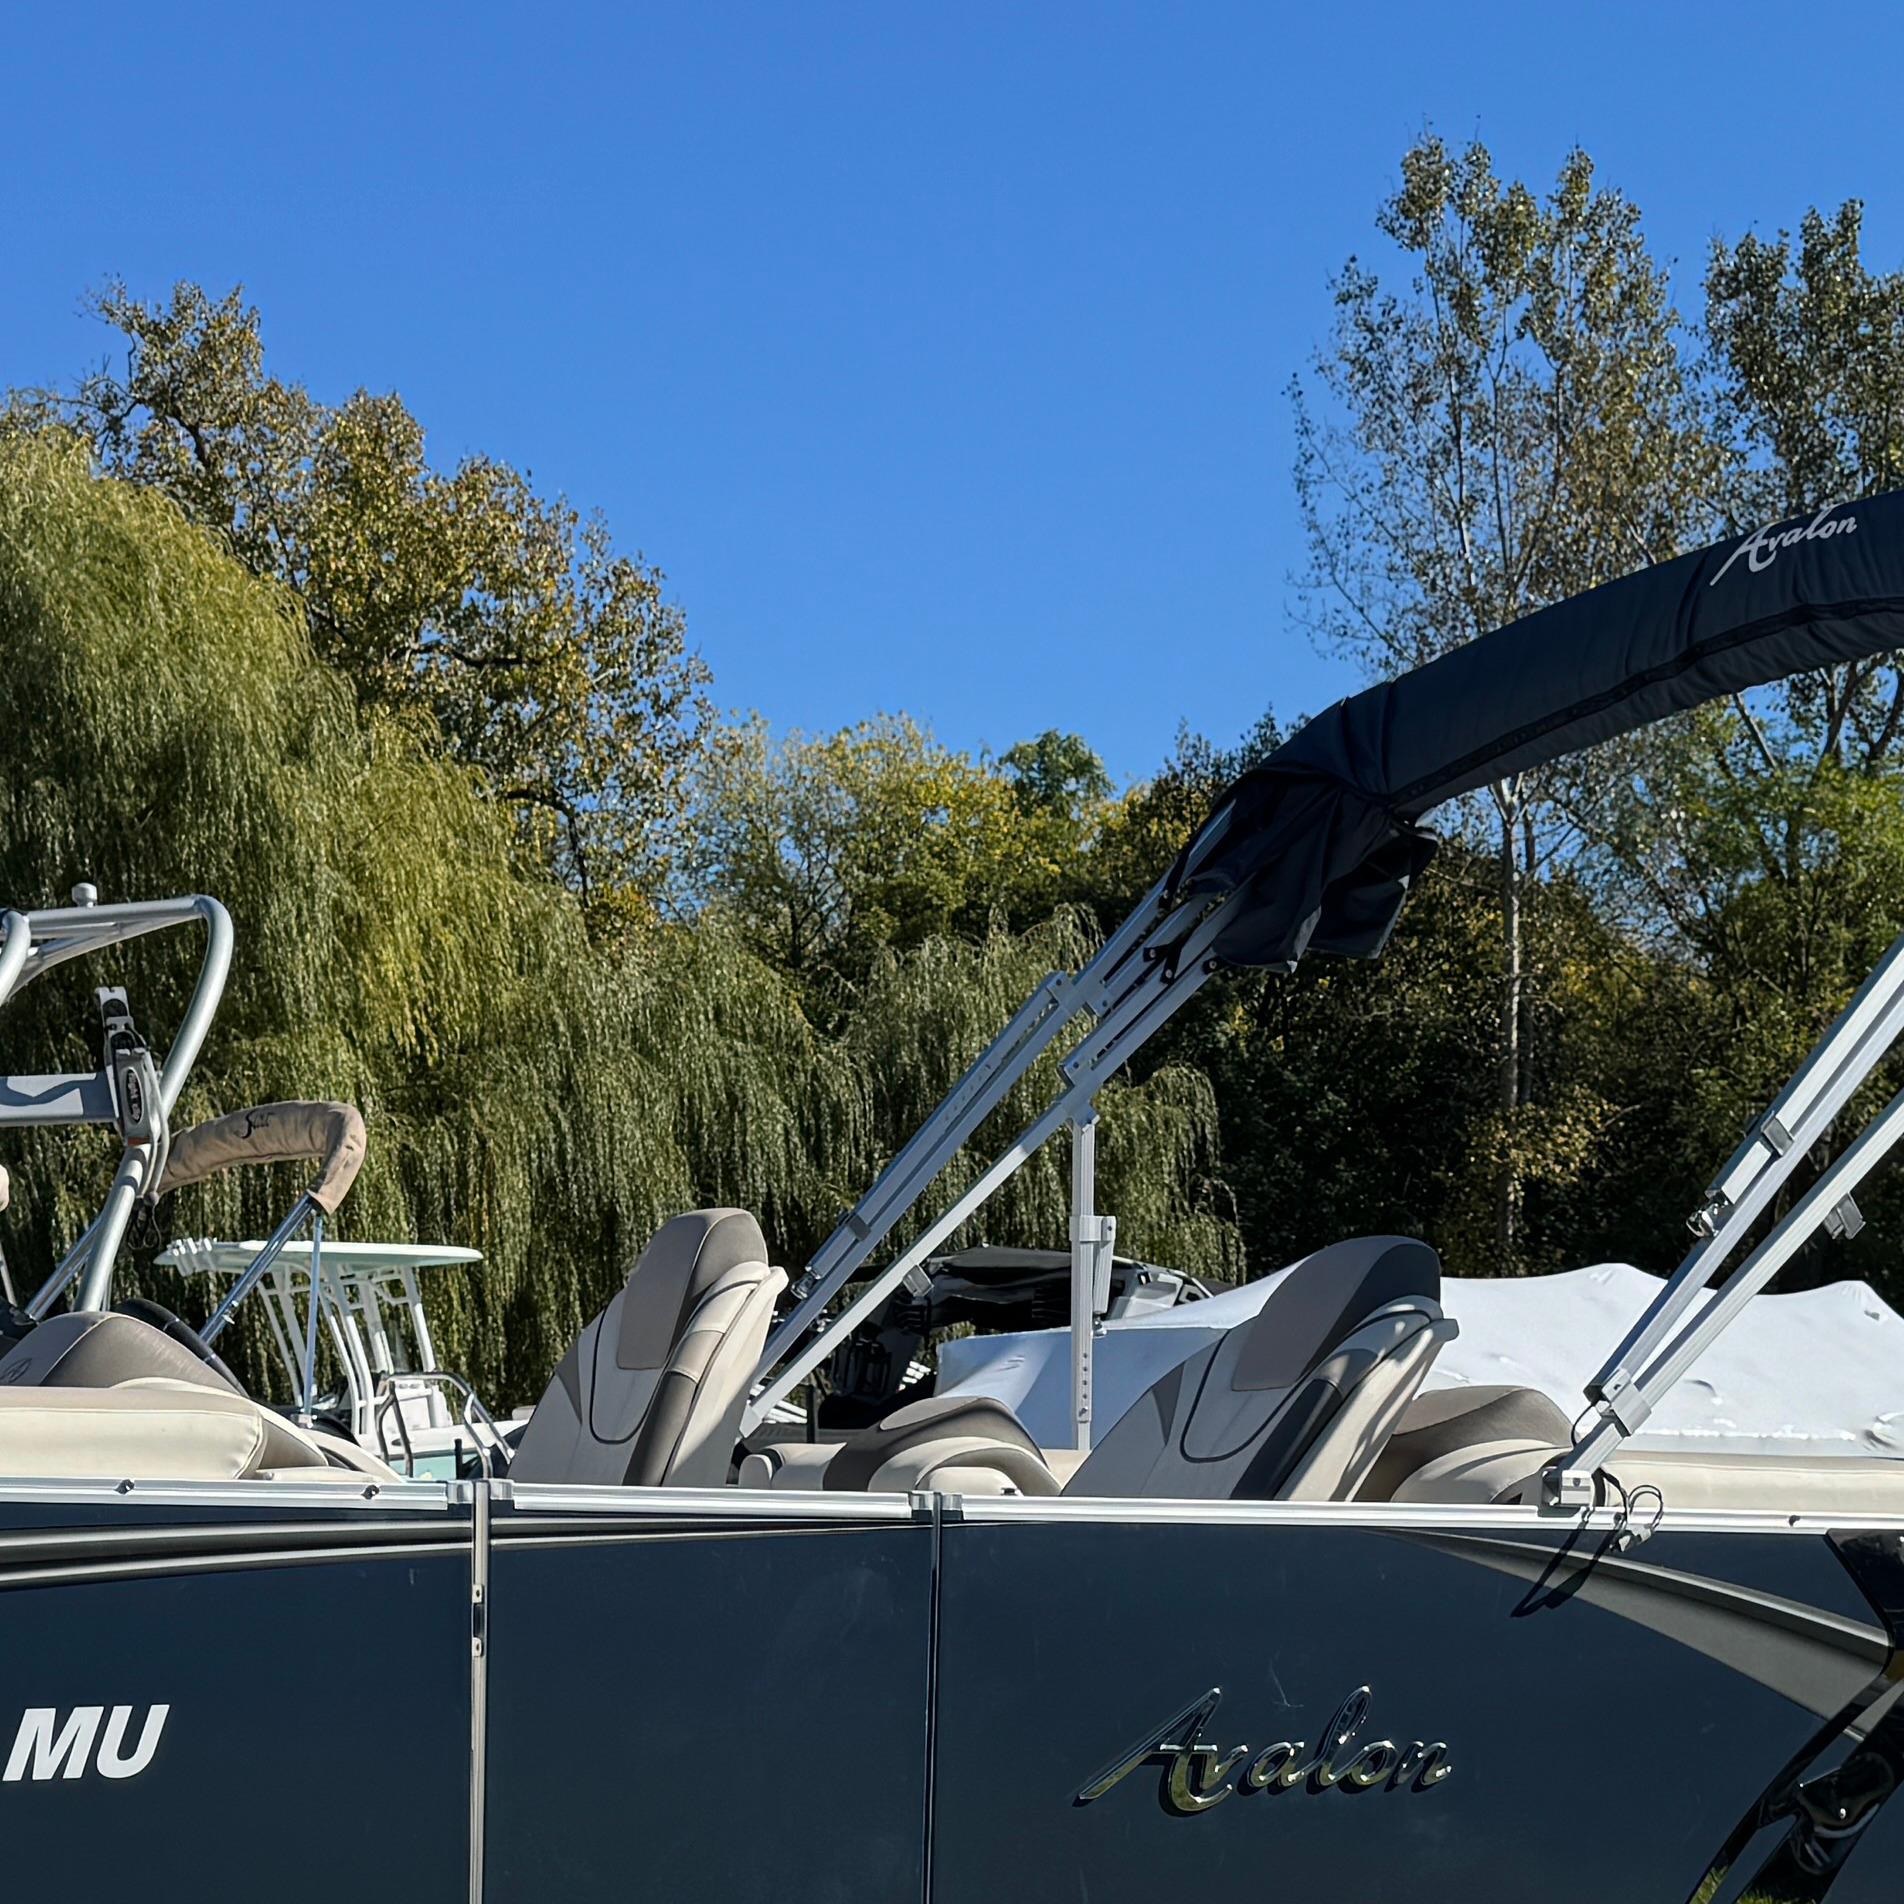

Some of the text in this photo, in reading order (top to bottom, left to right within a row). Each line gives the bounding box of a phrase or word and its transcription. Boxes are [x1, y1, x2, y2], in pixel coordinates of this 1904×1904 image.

[1709, 504, 1857, 587] Avalon
[2, 1704, 169, 1782] MU
[1079, 1685, 1453, 1813] Avalon
